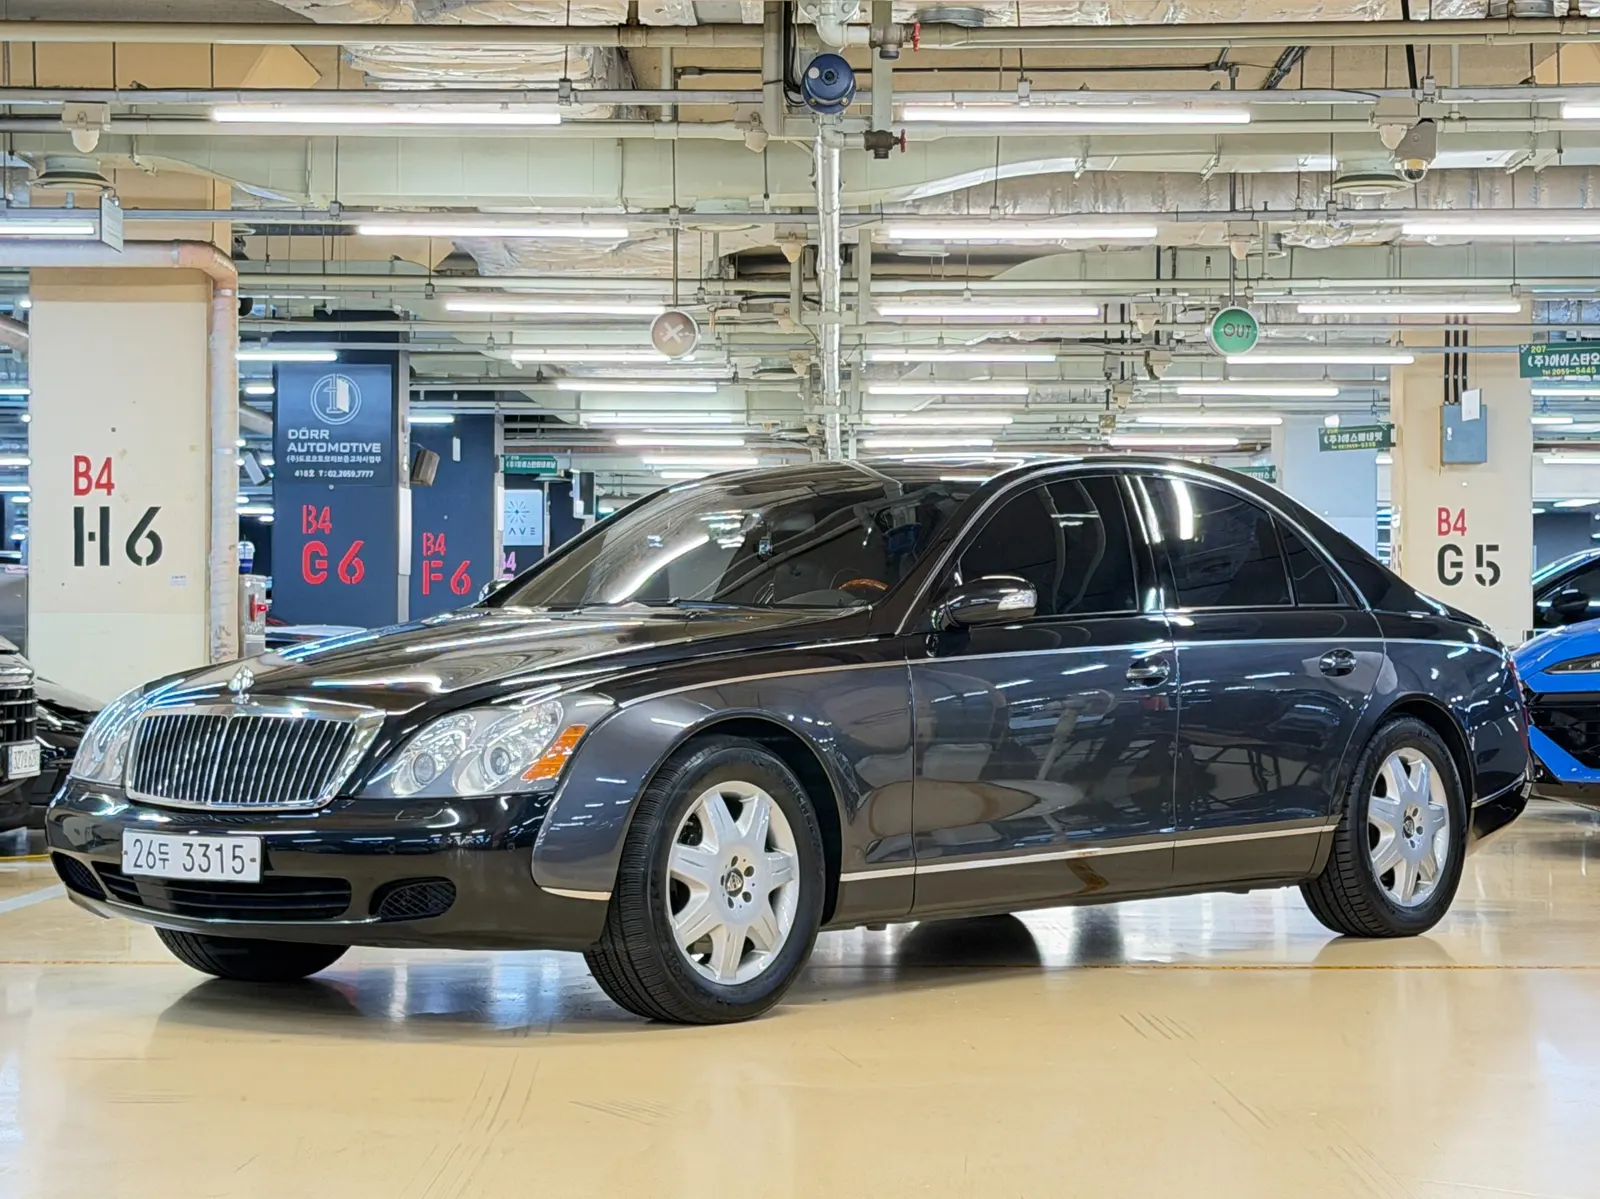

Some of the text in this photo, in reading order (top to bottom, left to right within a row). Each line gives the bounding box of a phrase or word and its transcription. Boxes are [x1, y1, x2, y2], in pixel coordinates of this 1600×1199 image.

[1223, 323, 1251, 338] OUT
[1531, 345, 1546, 353] 207
[288, 427, 330, 439] DÖRR
[287, 442, 381, 453] AUTOMOTIVE
[74, 455, 115, 496] B4
[302, 505, 332, 535] B4
[1437, 507, 1467, 536] B4
[422, 532, 446, 556] B4
[133, 838, 245, 875] 26두 3315
